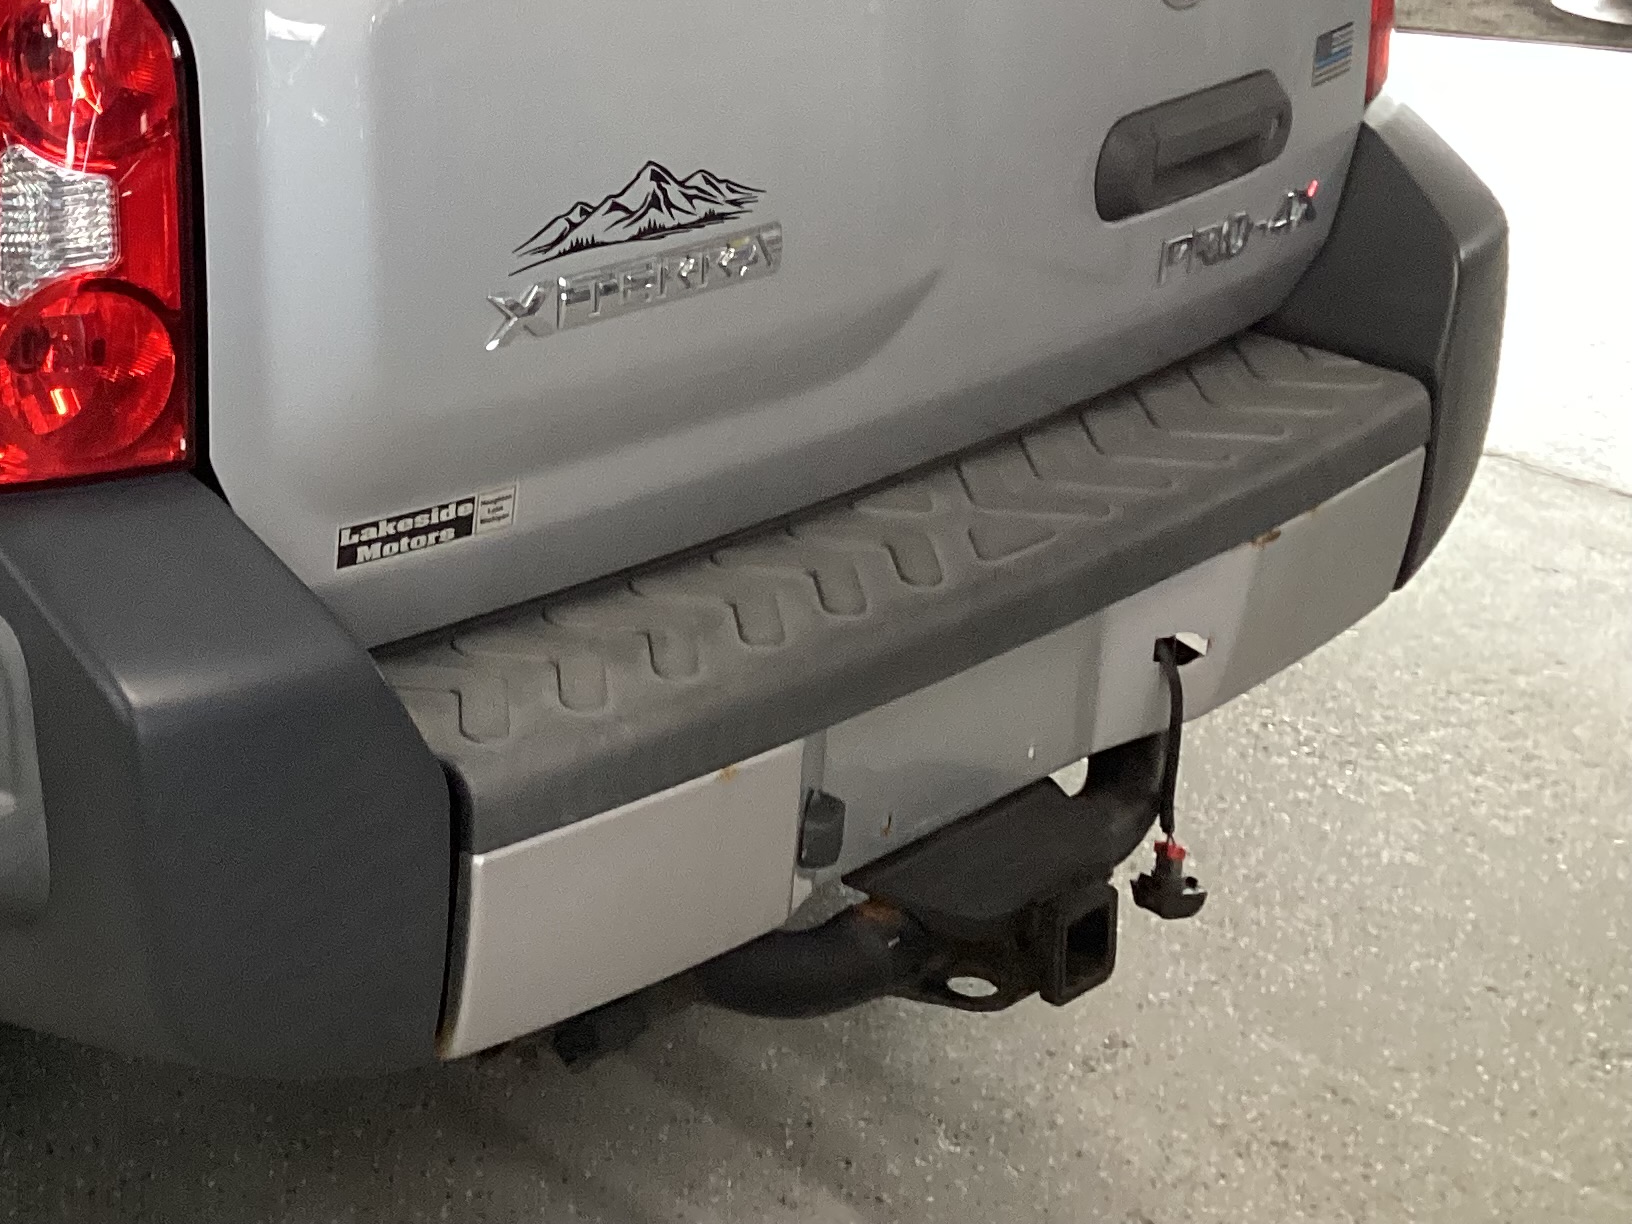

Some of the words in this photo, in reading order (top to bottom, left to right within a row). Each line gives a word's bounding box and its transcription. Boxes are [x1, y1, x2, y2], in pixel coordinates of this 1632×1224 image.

[484, 220, 783, 352] XTERRA
[340, 502, 474, 546] Lakeside
[356, 527, 456, 564] Motors
